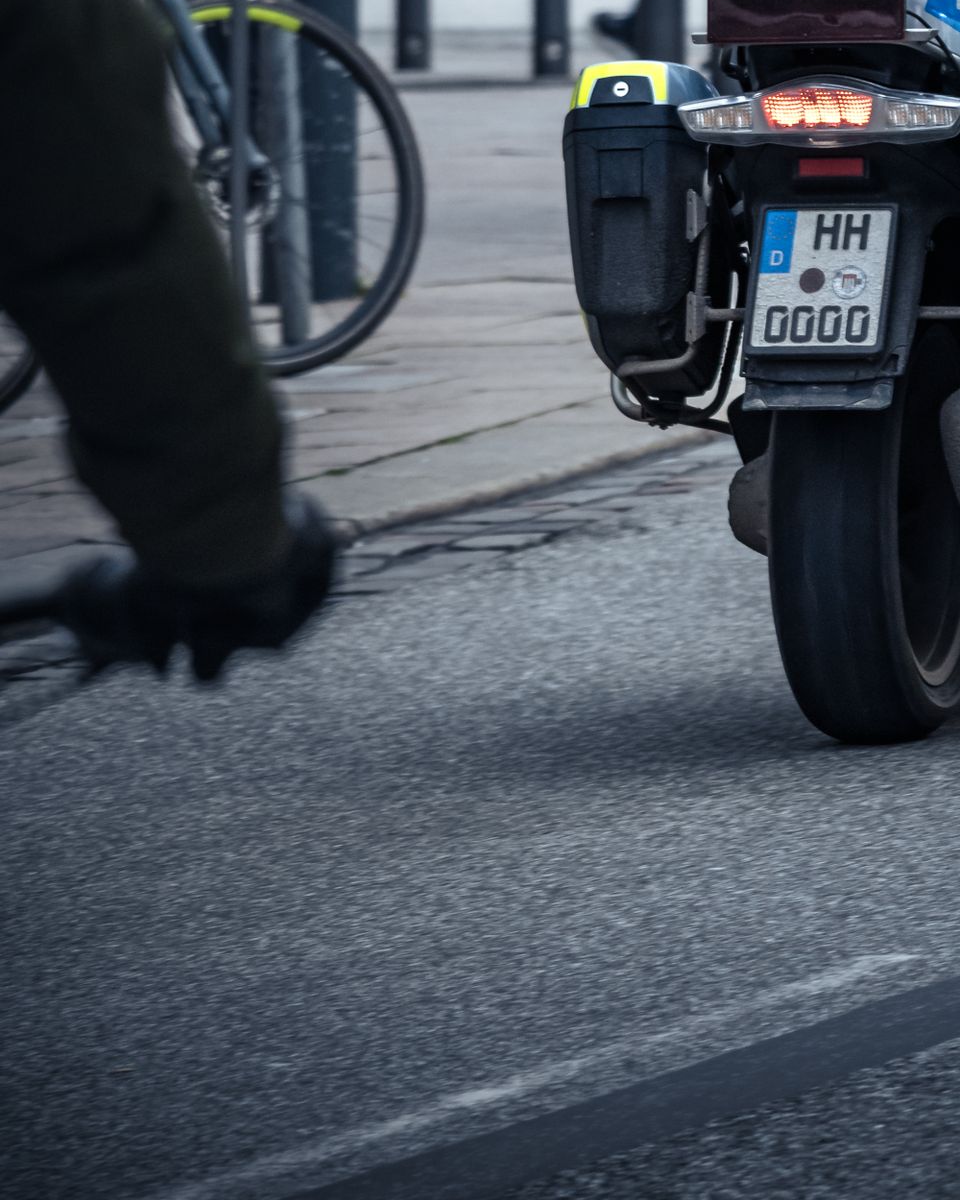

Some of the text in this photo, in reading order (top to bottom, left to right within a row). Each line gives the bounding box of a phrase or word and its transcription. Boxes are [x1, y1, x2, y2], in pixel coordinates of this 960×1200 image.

[813, 213, 872, 251] HH
[769, 250, 784, 266] D
[764, 305, 870, 344] 0000
